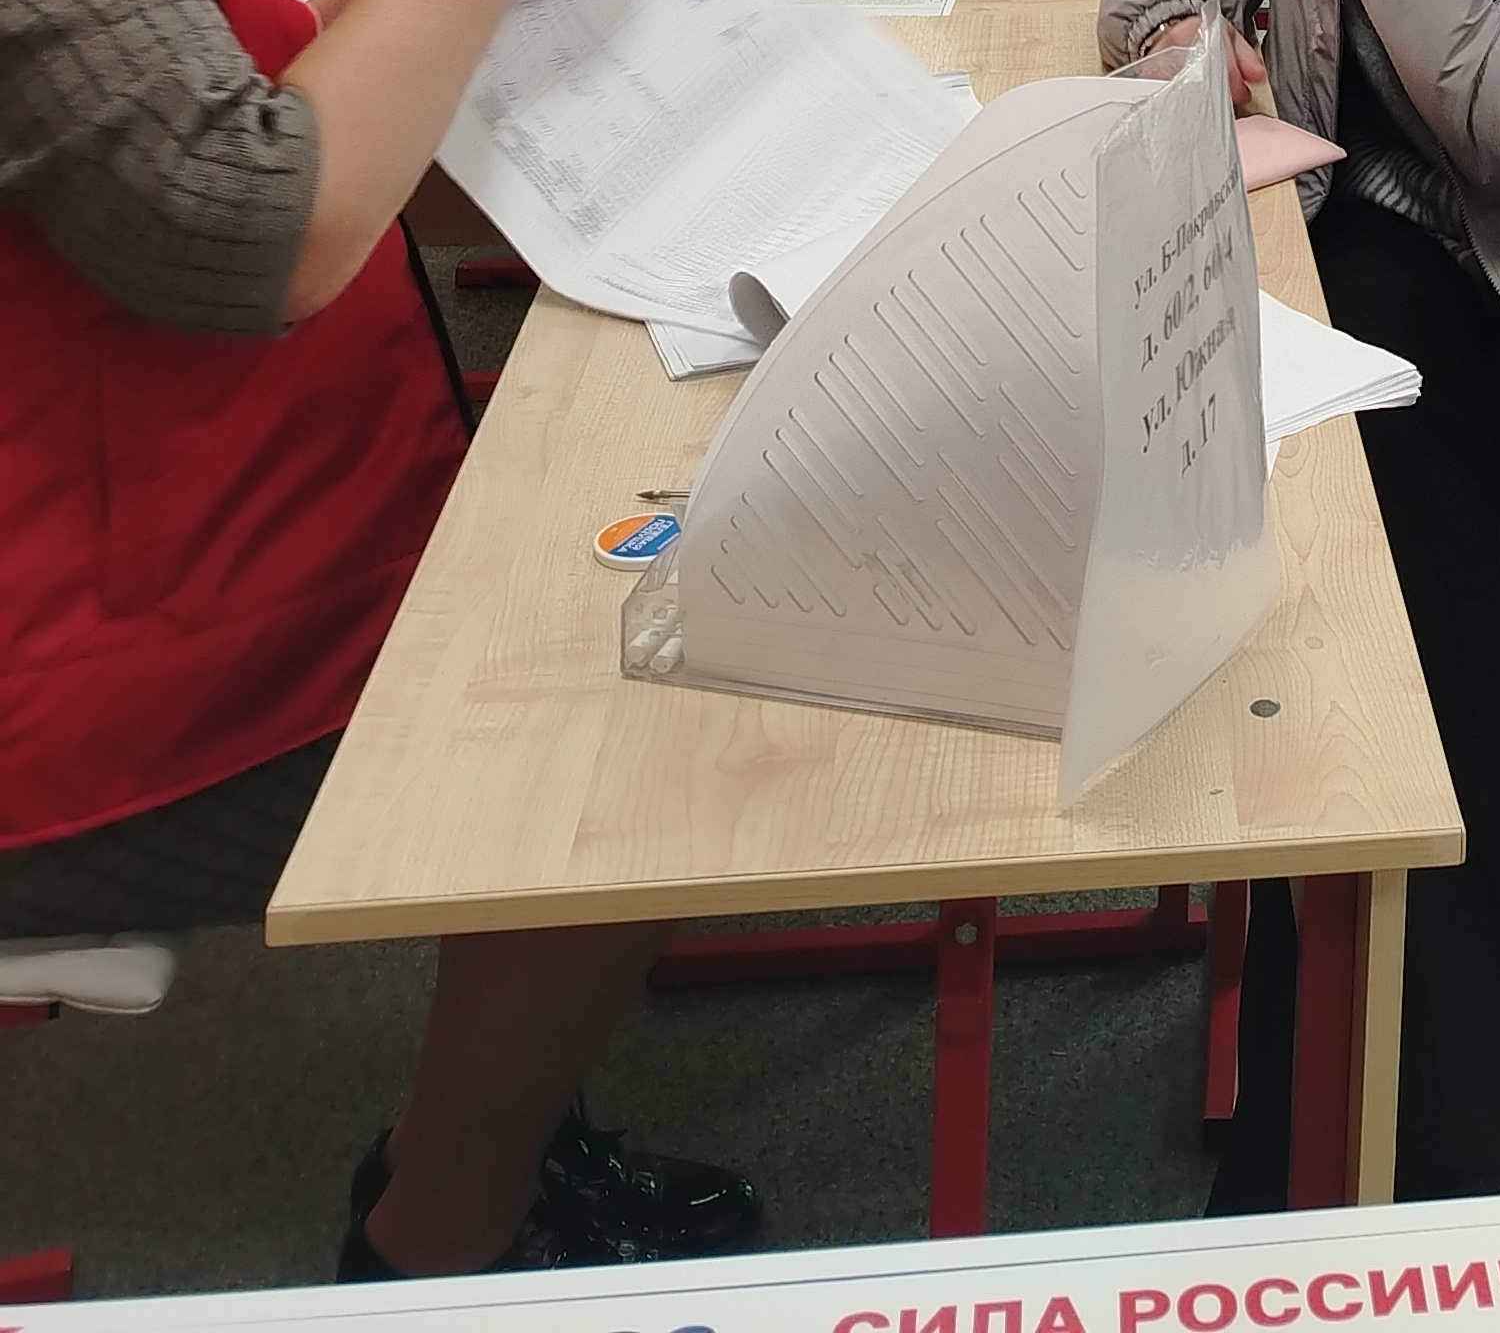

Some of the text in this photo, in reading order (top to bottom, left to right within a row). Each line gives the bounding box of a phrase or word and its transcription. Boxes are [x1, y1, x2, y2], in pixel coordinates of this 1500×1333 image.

[1134, 266, 1158, 311] ул.
[1141, 333, 1159, 373] д.
[1143, 394, 1172, 454] ул.
[1181, 391, 1217, 480] д. 17
